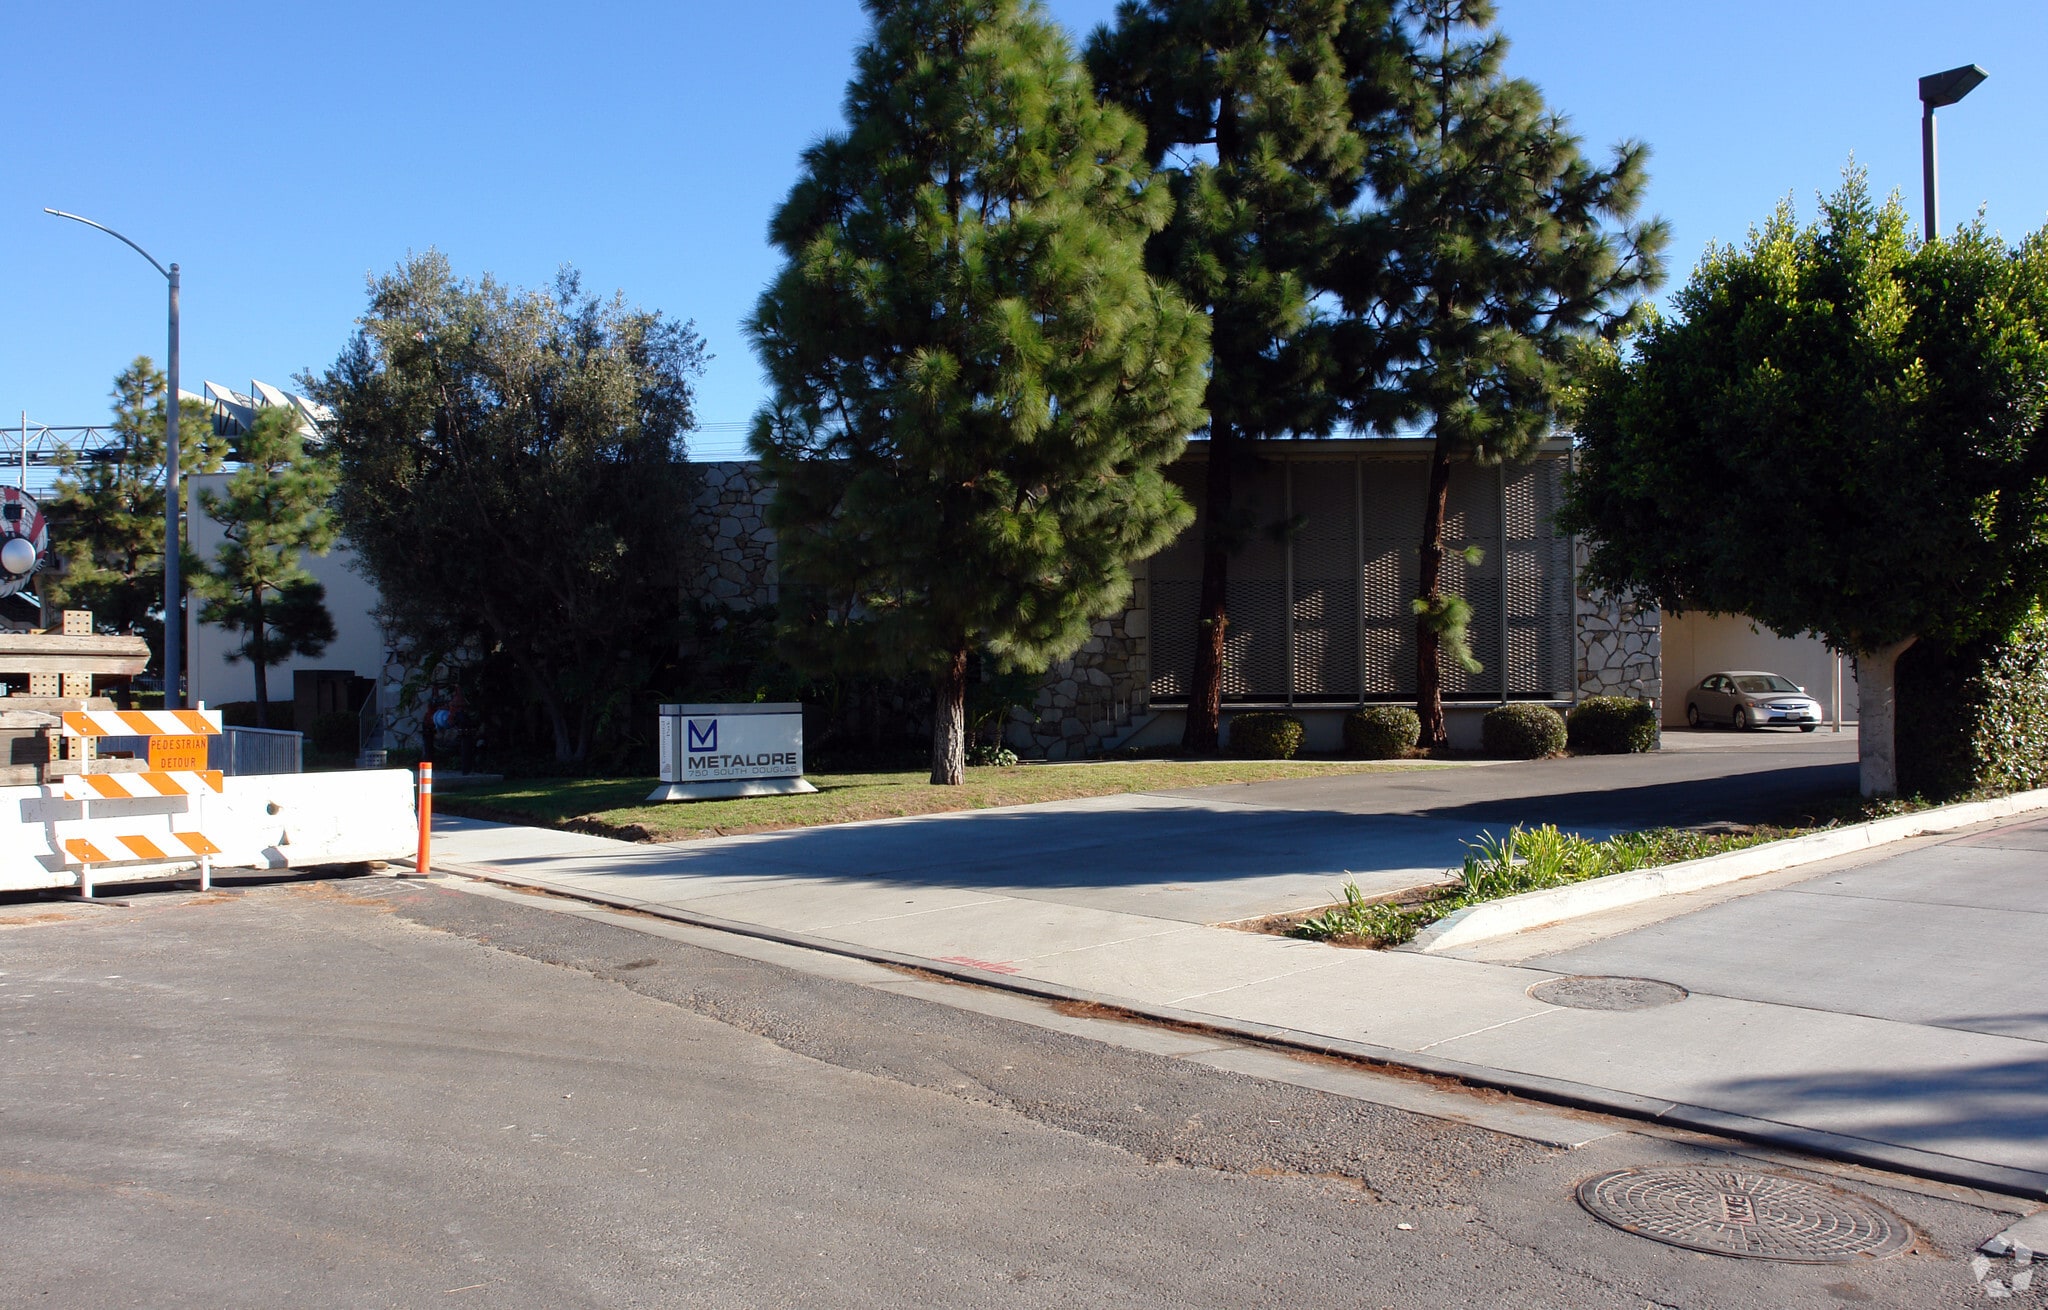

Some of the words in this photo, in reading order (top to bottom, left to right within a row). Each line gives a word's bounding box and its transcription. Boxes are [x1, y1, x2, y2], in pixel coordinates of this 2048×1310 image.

[151, 739, 206, 750] PEDESTRIAN
[161, 757, 196, 768] DETOUR
[688, 753, 796, 769] METALORE
[713, 767, 747, 776] SOUTH
[752, 765, 797, 775] DOUGLAS
